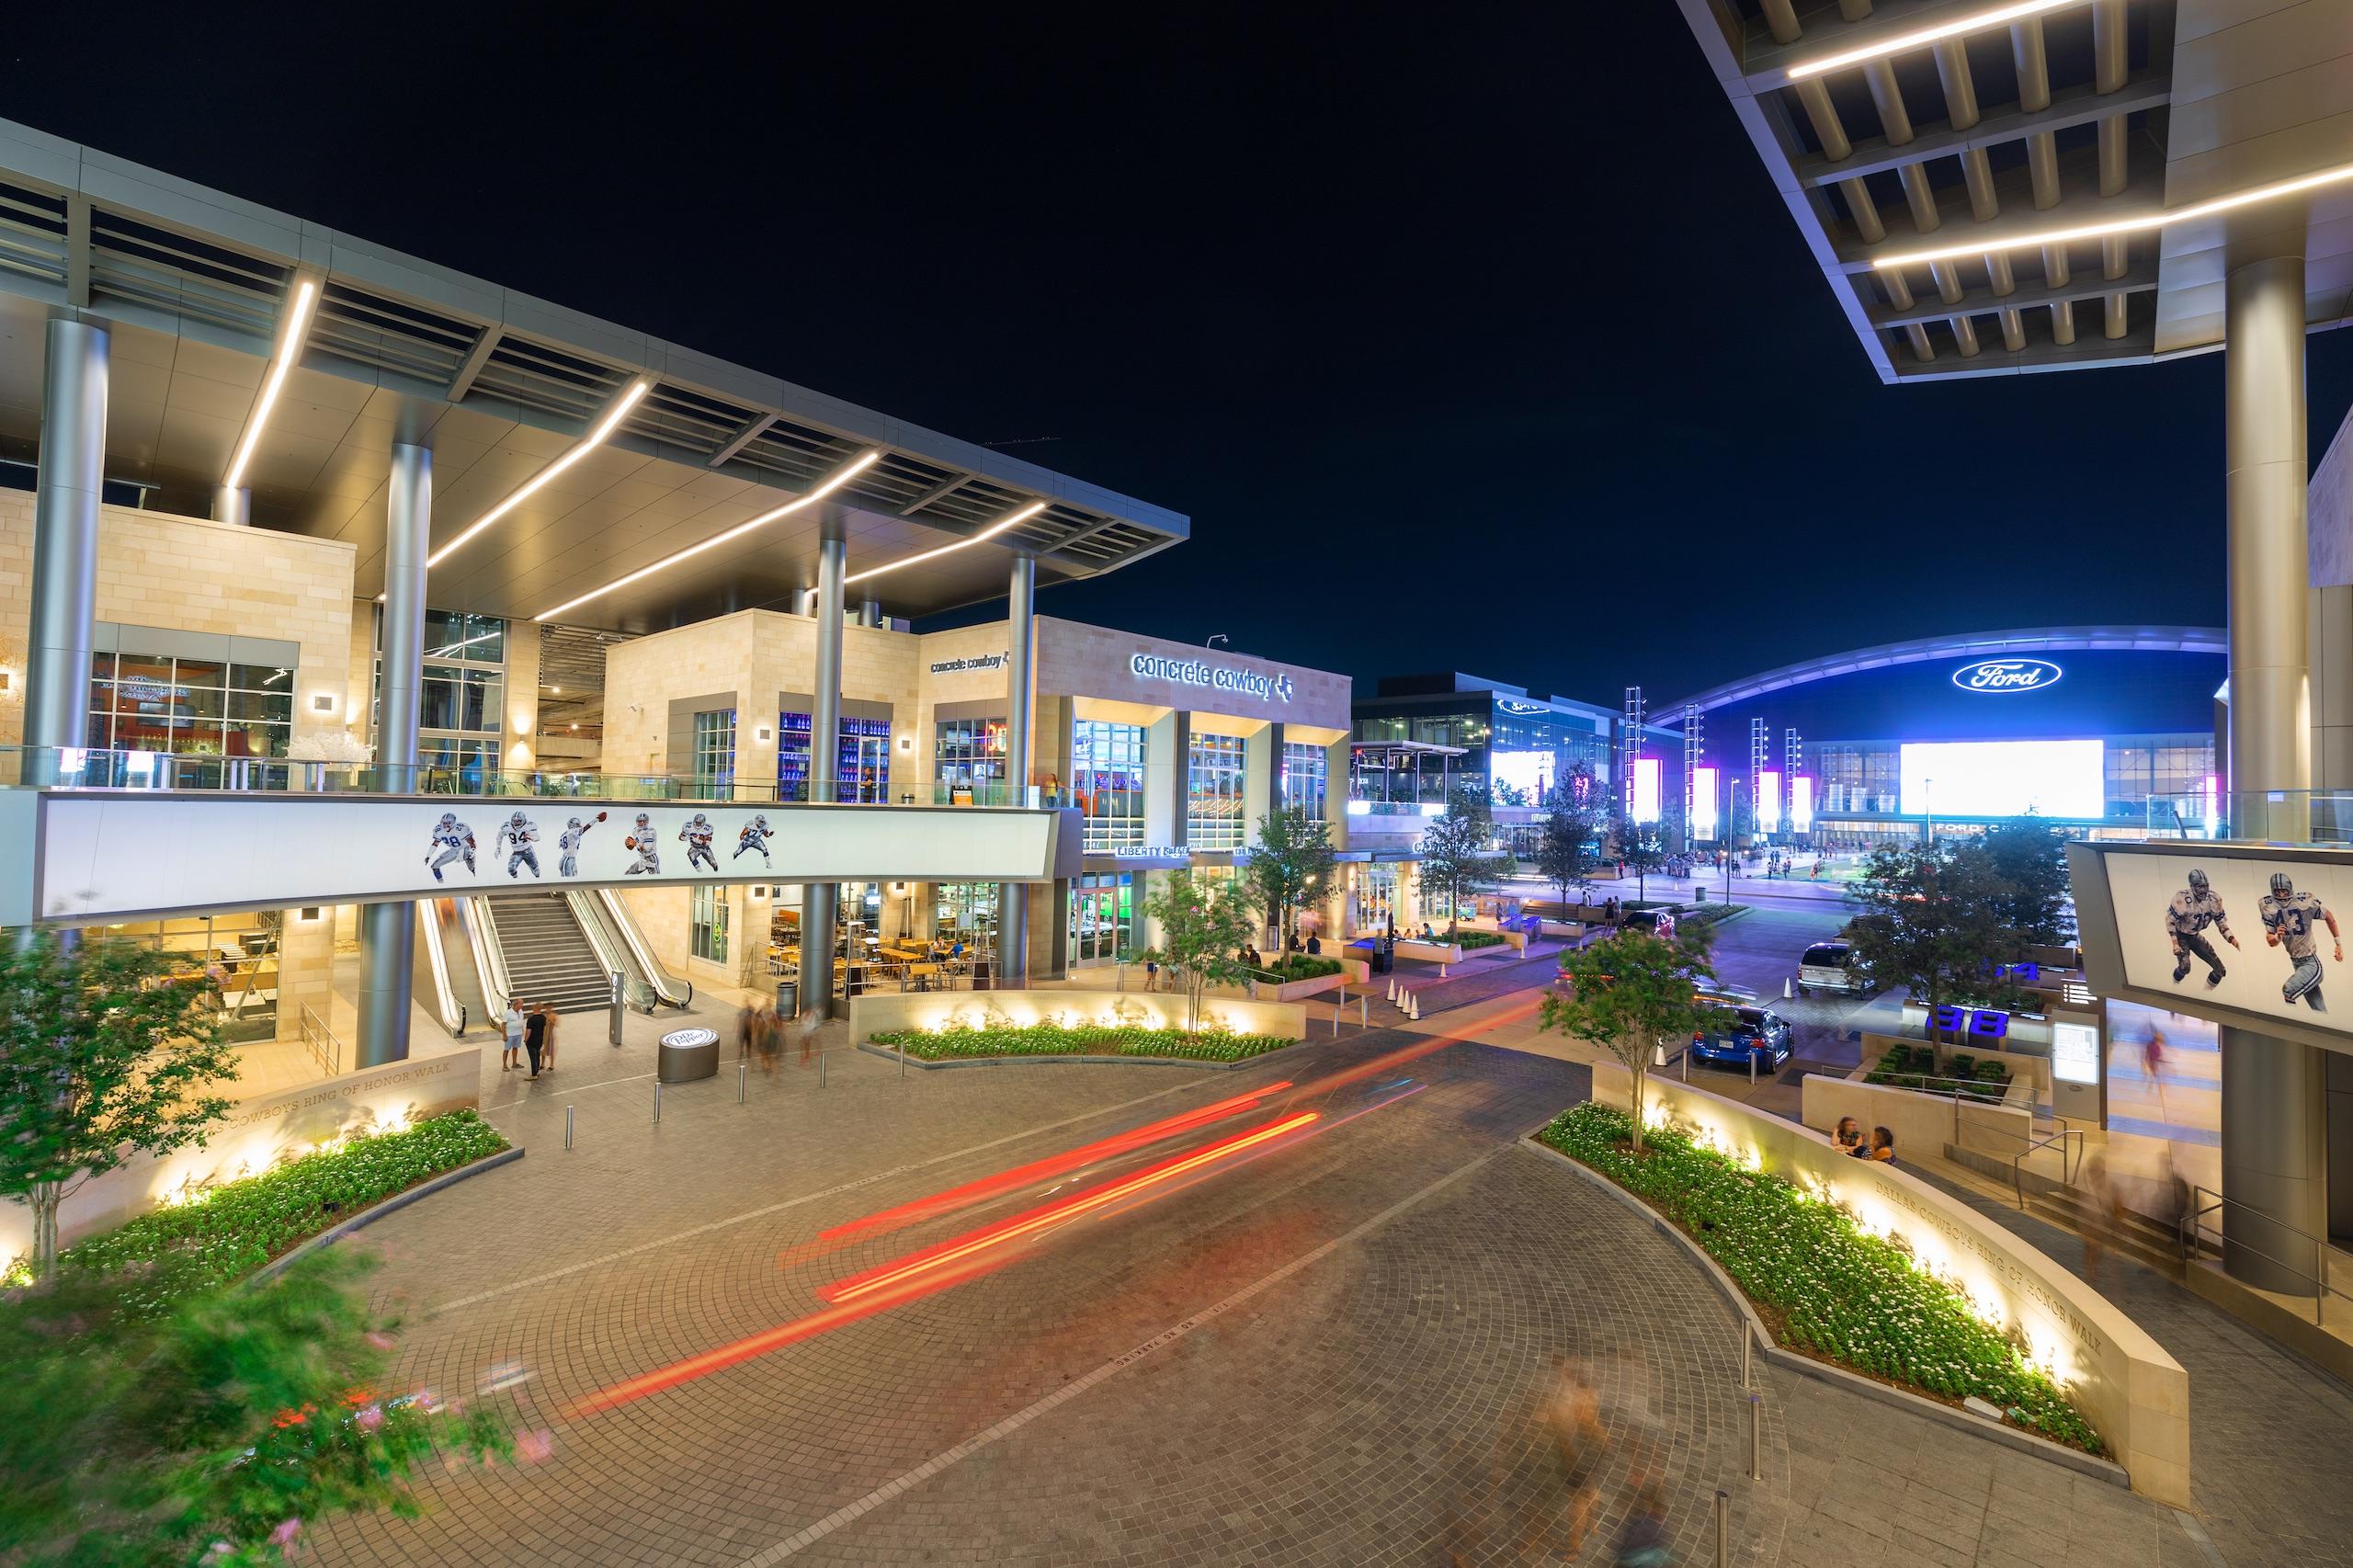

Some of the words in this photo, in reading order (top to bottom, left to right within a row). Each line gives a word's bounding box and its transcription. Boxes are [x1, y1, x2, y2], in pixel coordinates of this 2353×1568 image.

[931, 659, 966, 673] concrete
[967, 654, 1001, 669] cowboy
[1971, 664, 2041, 687] Ford
[1132, 654, 1211, 684] concrete
[1214, 669, 1274, 699] cowboy
[508, 831, 529, 844] 94
[1936, 824, 1980, 832] FORD
[1117, 846, 1161, 857] LIBERTY
[2274, 908, 2306, 936] 43
[1926, 1005, 2010, 1038] 88
[672, 1032, 704, 1045] Pepper
[229, 1100, 299, 1129] COWBOYS
[304, 1090, 337, 1108] RING
[342, 1084, 361, 1096] OF
[364, 1072, 410, 1092] HONOR
[414, 1062, 450, 1078] WALK
[1875, 1180, 1917, 1213] DALLAS
[1919, 1207, 1974, 1250] COWBOYS
[1977, 1242, 2006, 1273] RING
[2007, 1266, 2024, 1286] OF
[2027, 1278, 2067, 1324] HONOR
[2069, 1312, 2103, 1358] WALK
[1116, 1340, 1161, 1367] PARKING
